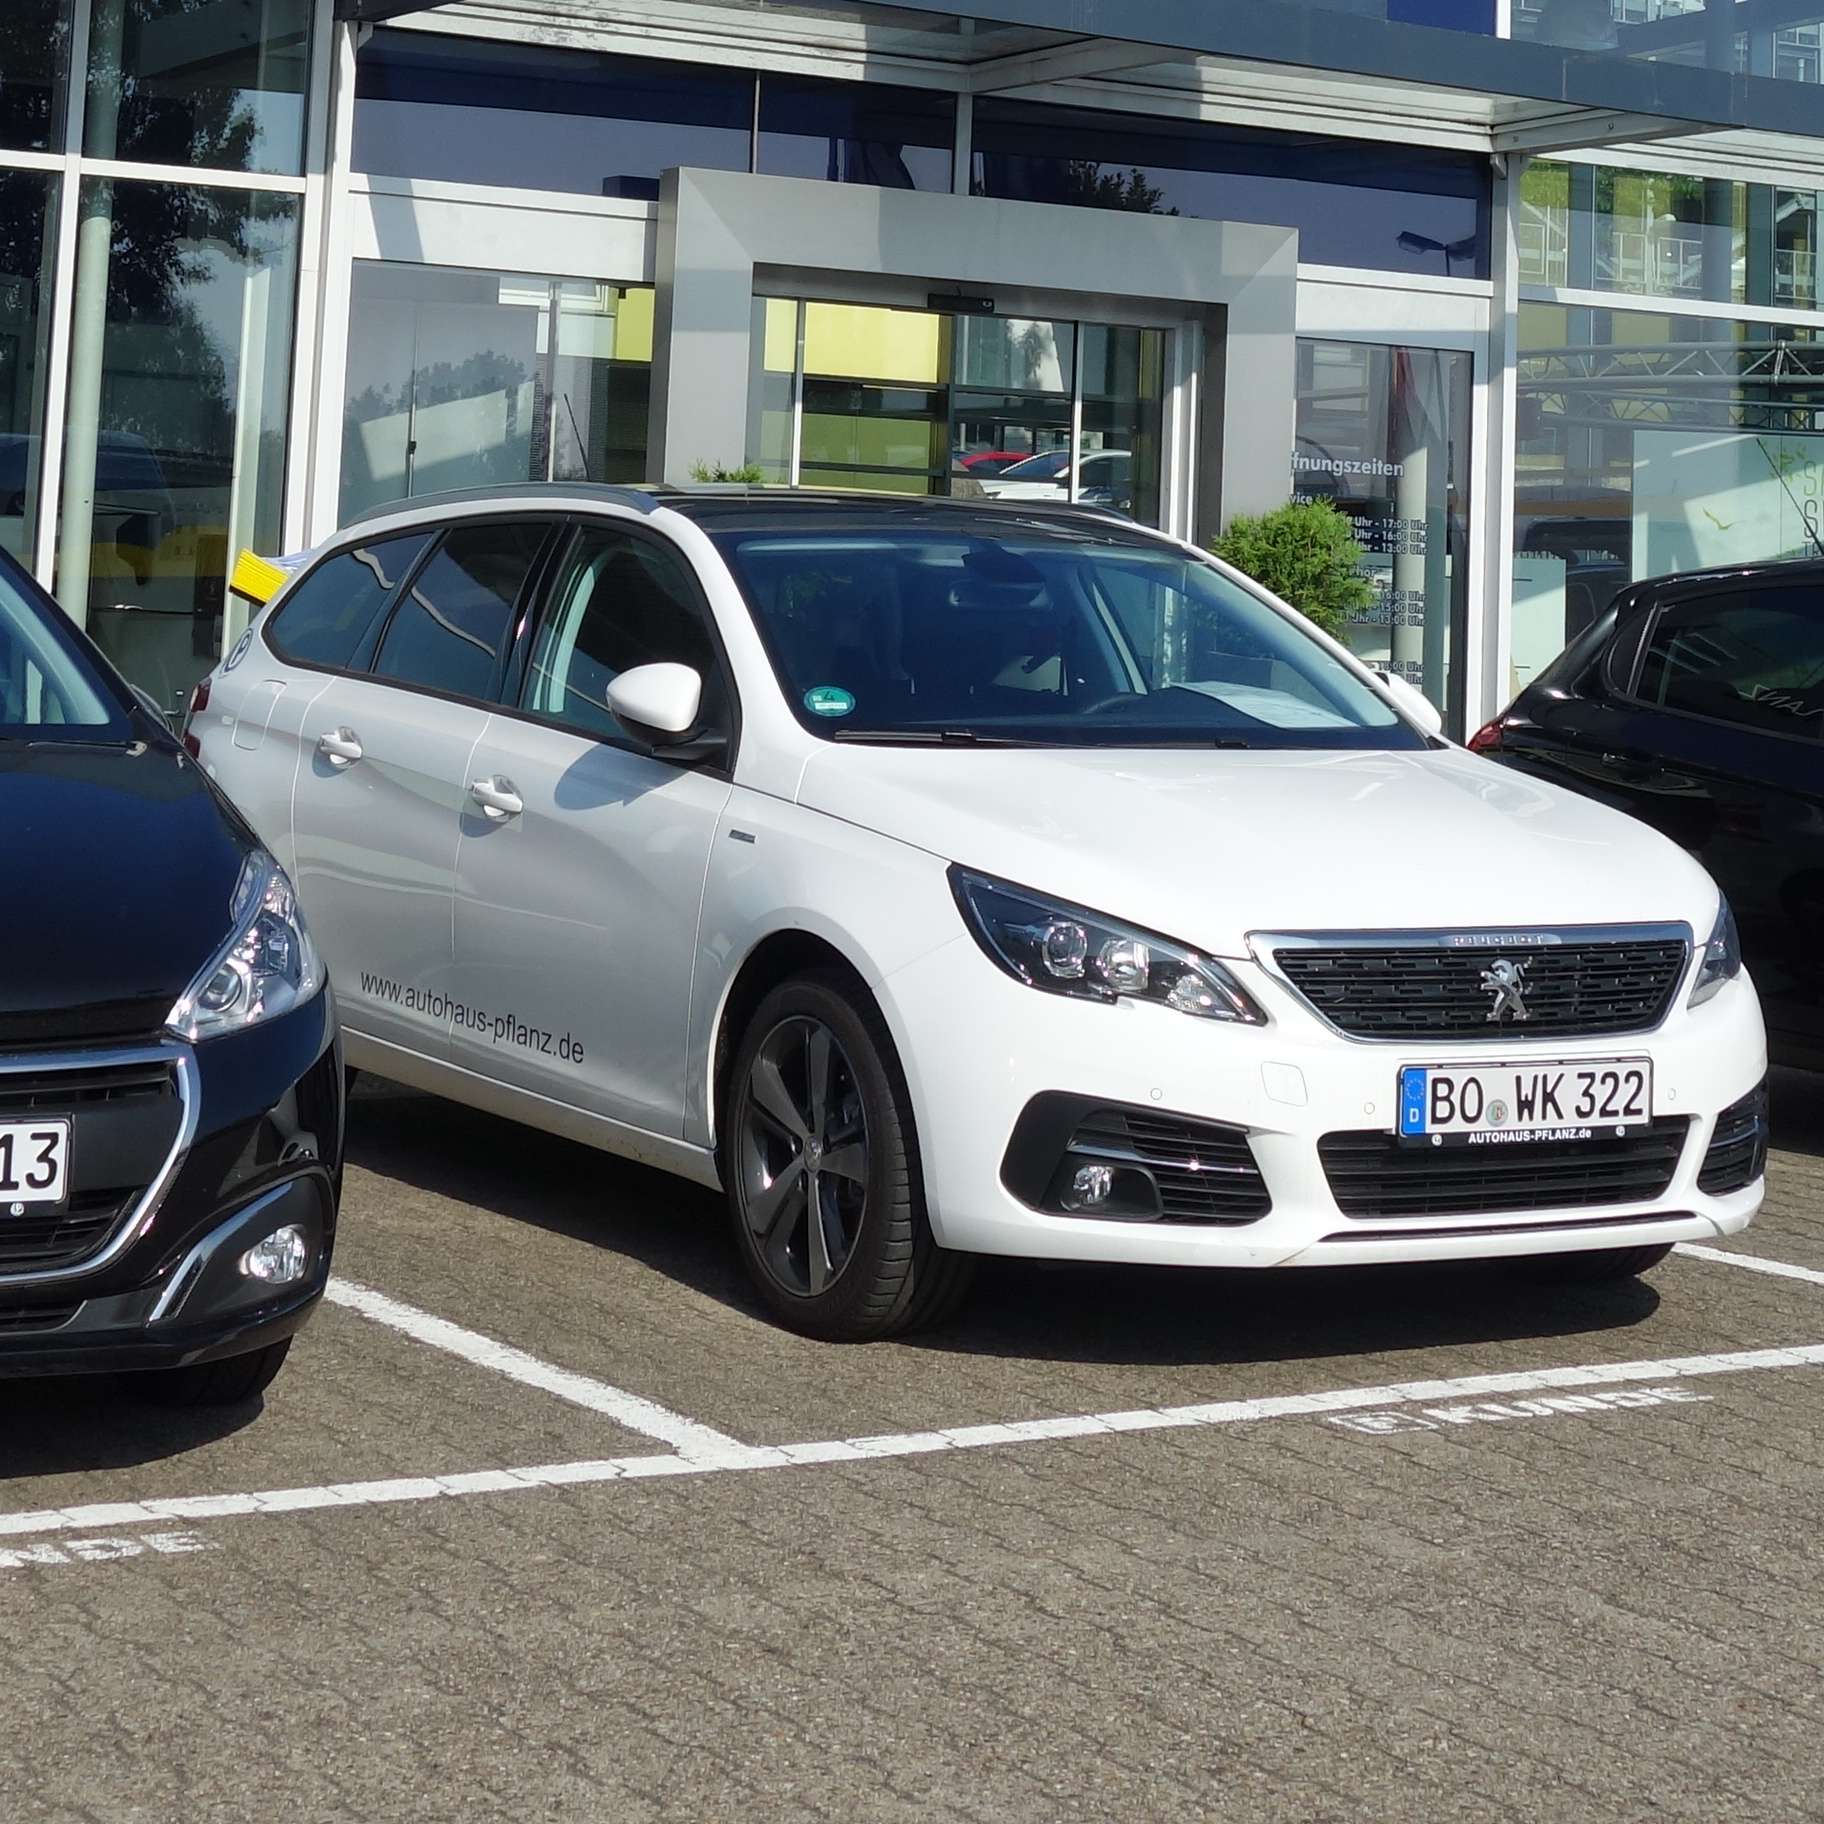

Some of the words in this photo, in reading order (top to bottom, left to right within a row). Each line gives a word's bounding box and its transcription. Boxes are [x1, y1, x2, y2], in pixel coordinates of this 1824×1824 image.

[1382, 518, 1409, 529] 17:00
[360, 971, 585, 1064] www.autohaus-pflanz.de
[1430, 1076, 1484, 1125] BO
[1515, 1072, 1565, 1122] WK
[1574, 1070, 1644, 1120] 322
[1409, 1108, 1420, 1123] D
[1468, 1127, 1592, 1145] AUTOHAUS-PFLANZ.de
[1422, 1387, 1714, 1424] KUNDE
